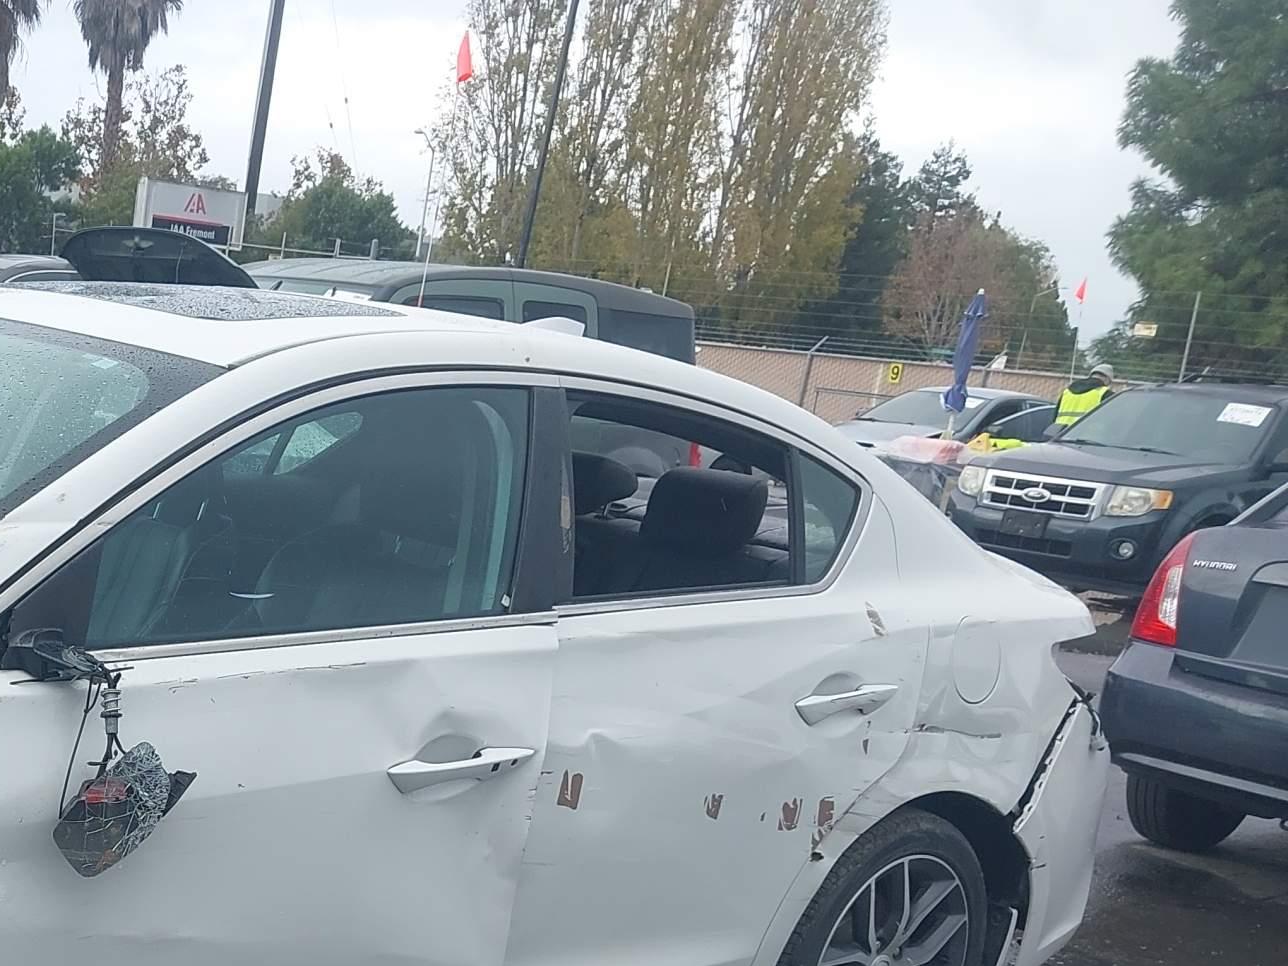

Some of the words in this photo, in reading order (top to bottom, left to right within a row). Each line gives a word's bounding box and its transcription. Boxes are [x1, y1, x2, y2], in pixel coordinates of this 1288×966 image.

[170, 223, 184, 234] IAA
[186, 226, 215, 239] Fremont
[890, 365, 900, 381] 9
[1193, 560, 1237, 570] HYUNDAI
